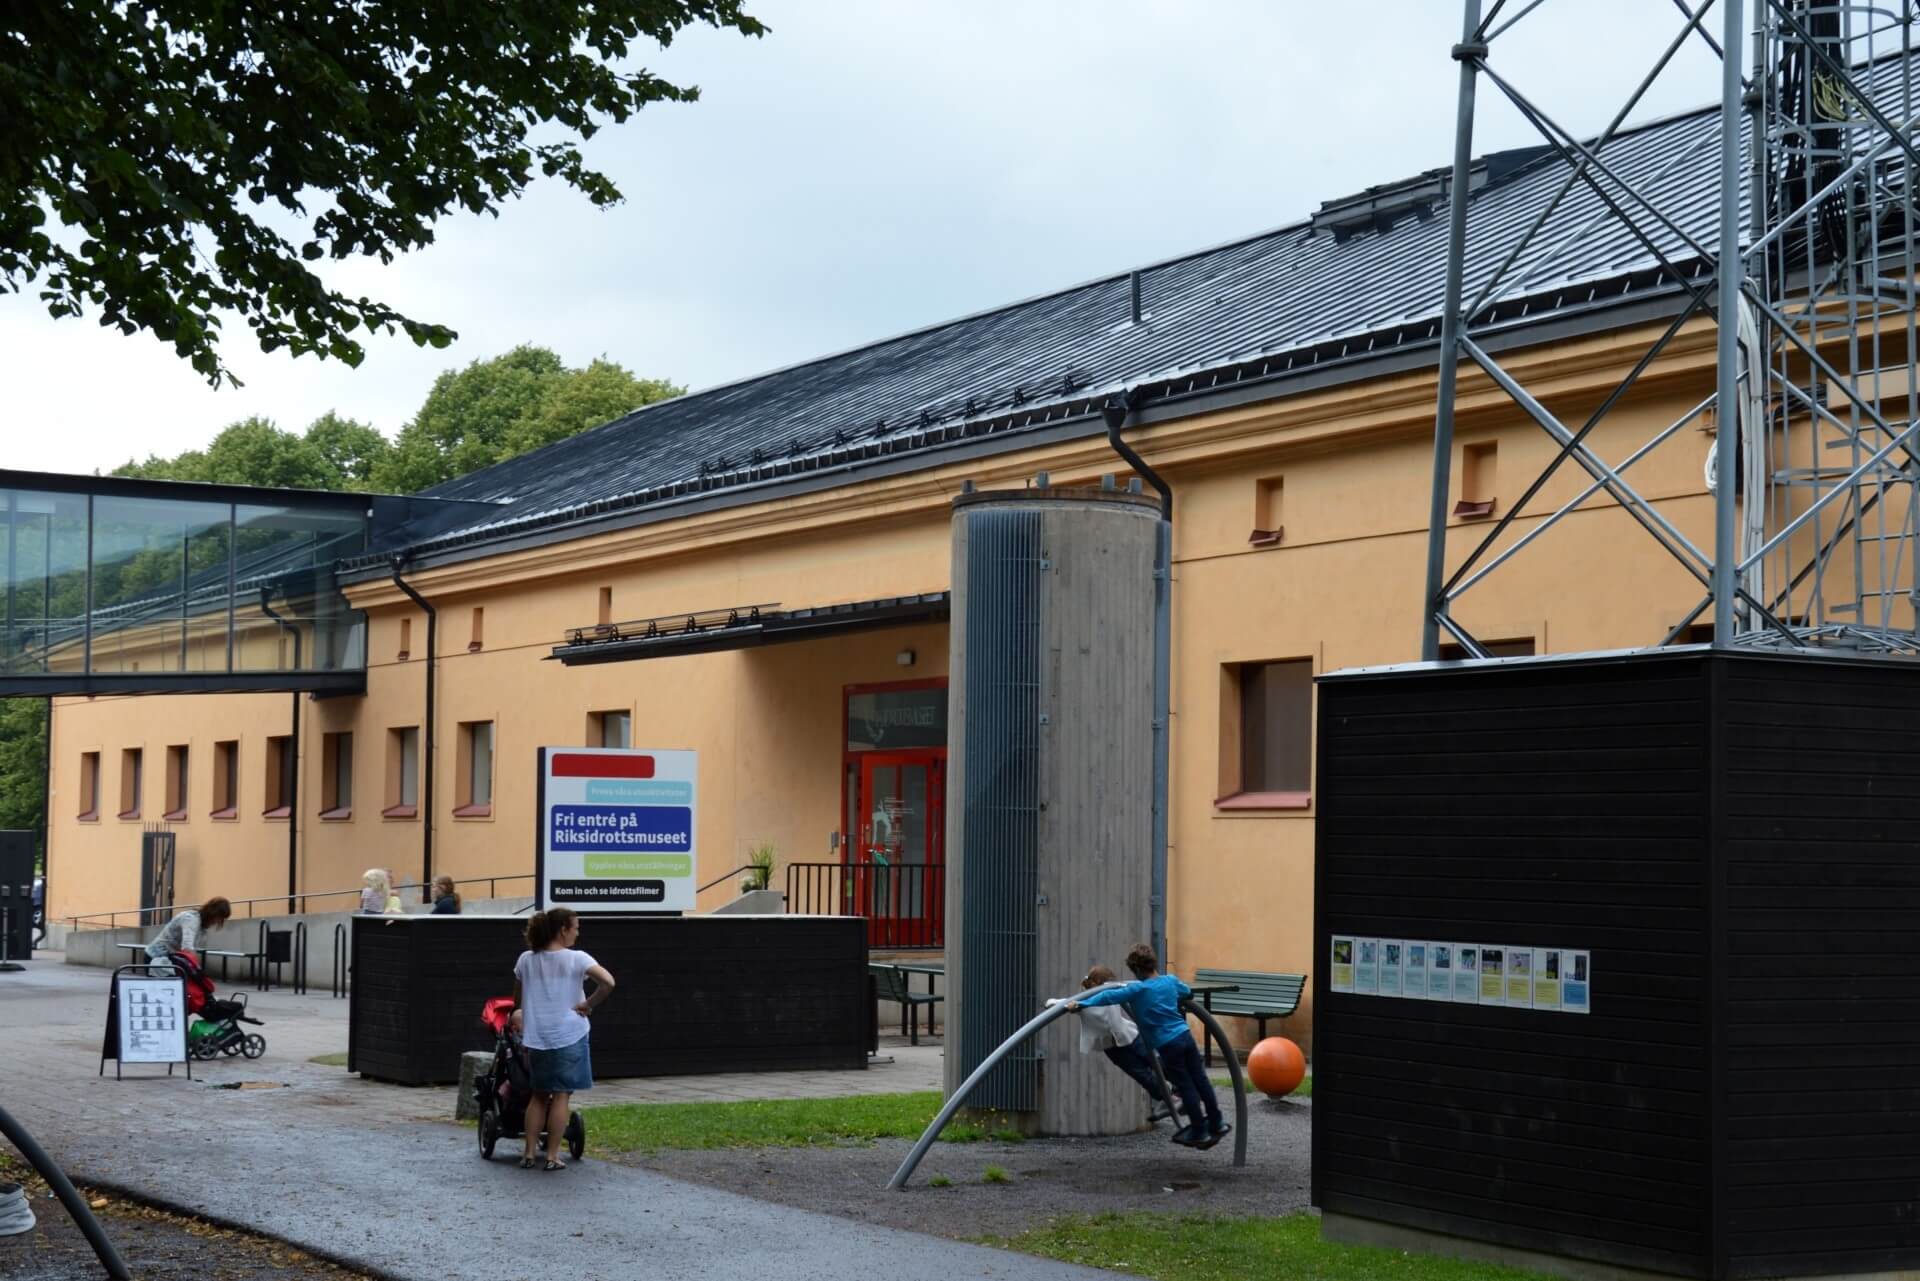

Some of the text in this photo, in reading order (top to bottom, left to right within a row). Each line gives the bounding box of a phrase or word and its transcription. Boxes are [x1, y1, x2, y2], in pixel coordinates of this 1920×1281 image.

[555, 812, 638, 830] Fri entré på
[555, 829, 687, 844] Riksidrottsmuseet
[555, 887, 573, 895] Kom
[575, 886, 583, 895] in
[584, 886, 599, 895] och
[609, 887, 659, 895] idrottsfilmer
